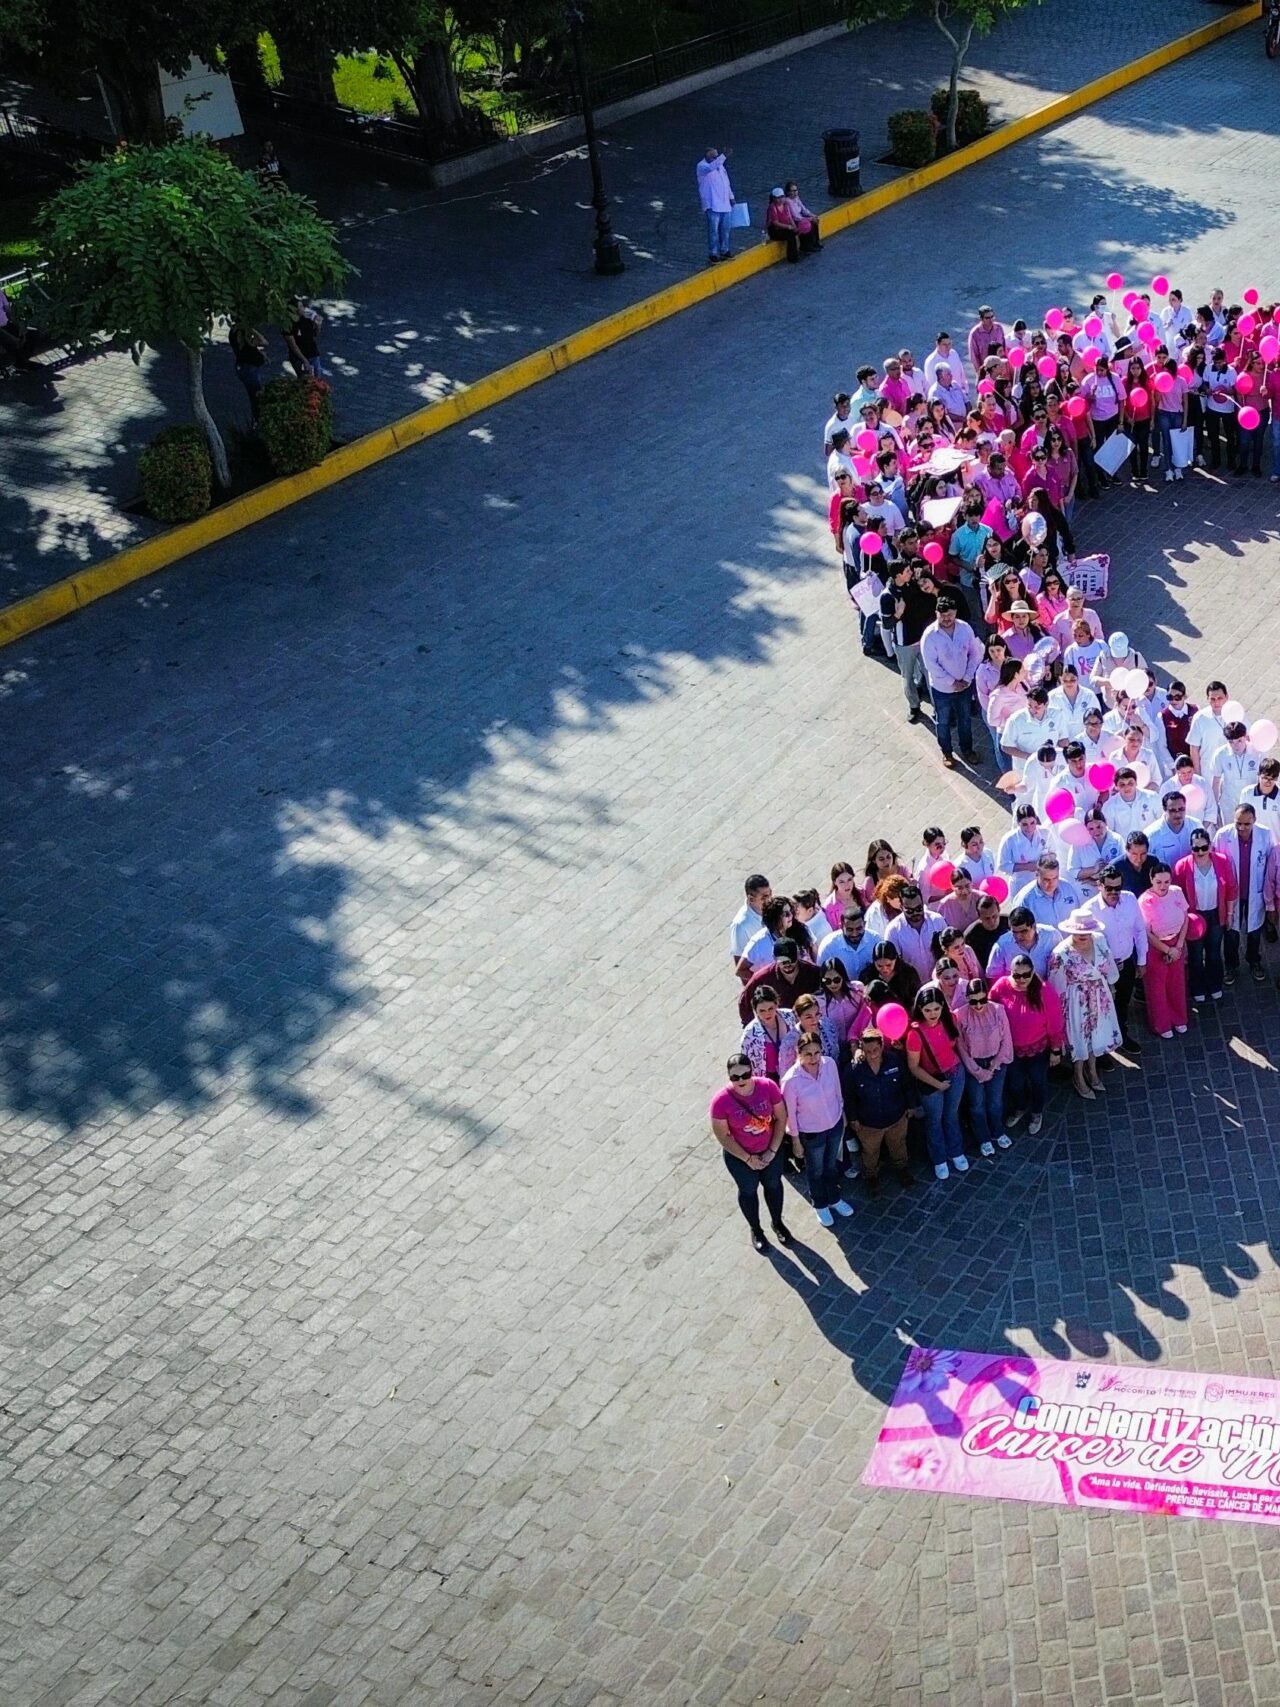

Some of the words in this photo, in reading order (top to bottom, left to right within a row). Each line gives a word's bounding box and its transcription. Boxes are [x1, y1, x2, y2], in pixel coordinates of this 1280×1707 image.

[1139, 1429, 1205, 1474] de
[1112, 1476, 1121, 1488] la
[1232, 1489, 1257, 1501] Lucha
[1259, 1493, 1274, 1503] por
[1165, 1494, 1204, 1507] PREVIENE
[1206, 1499, 1216, 1508] EL
[1252, 1502, 1262, 1512] DE
